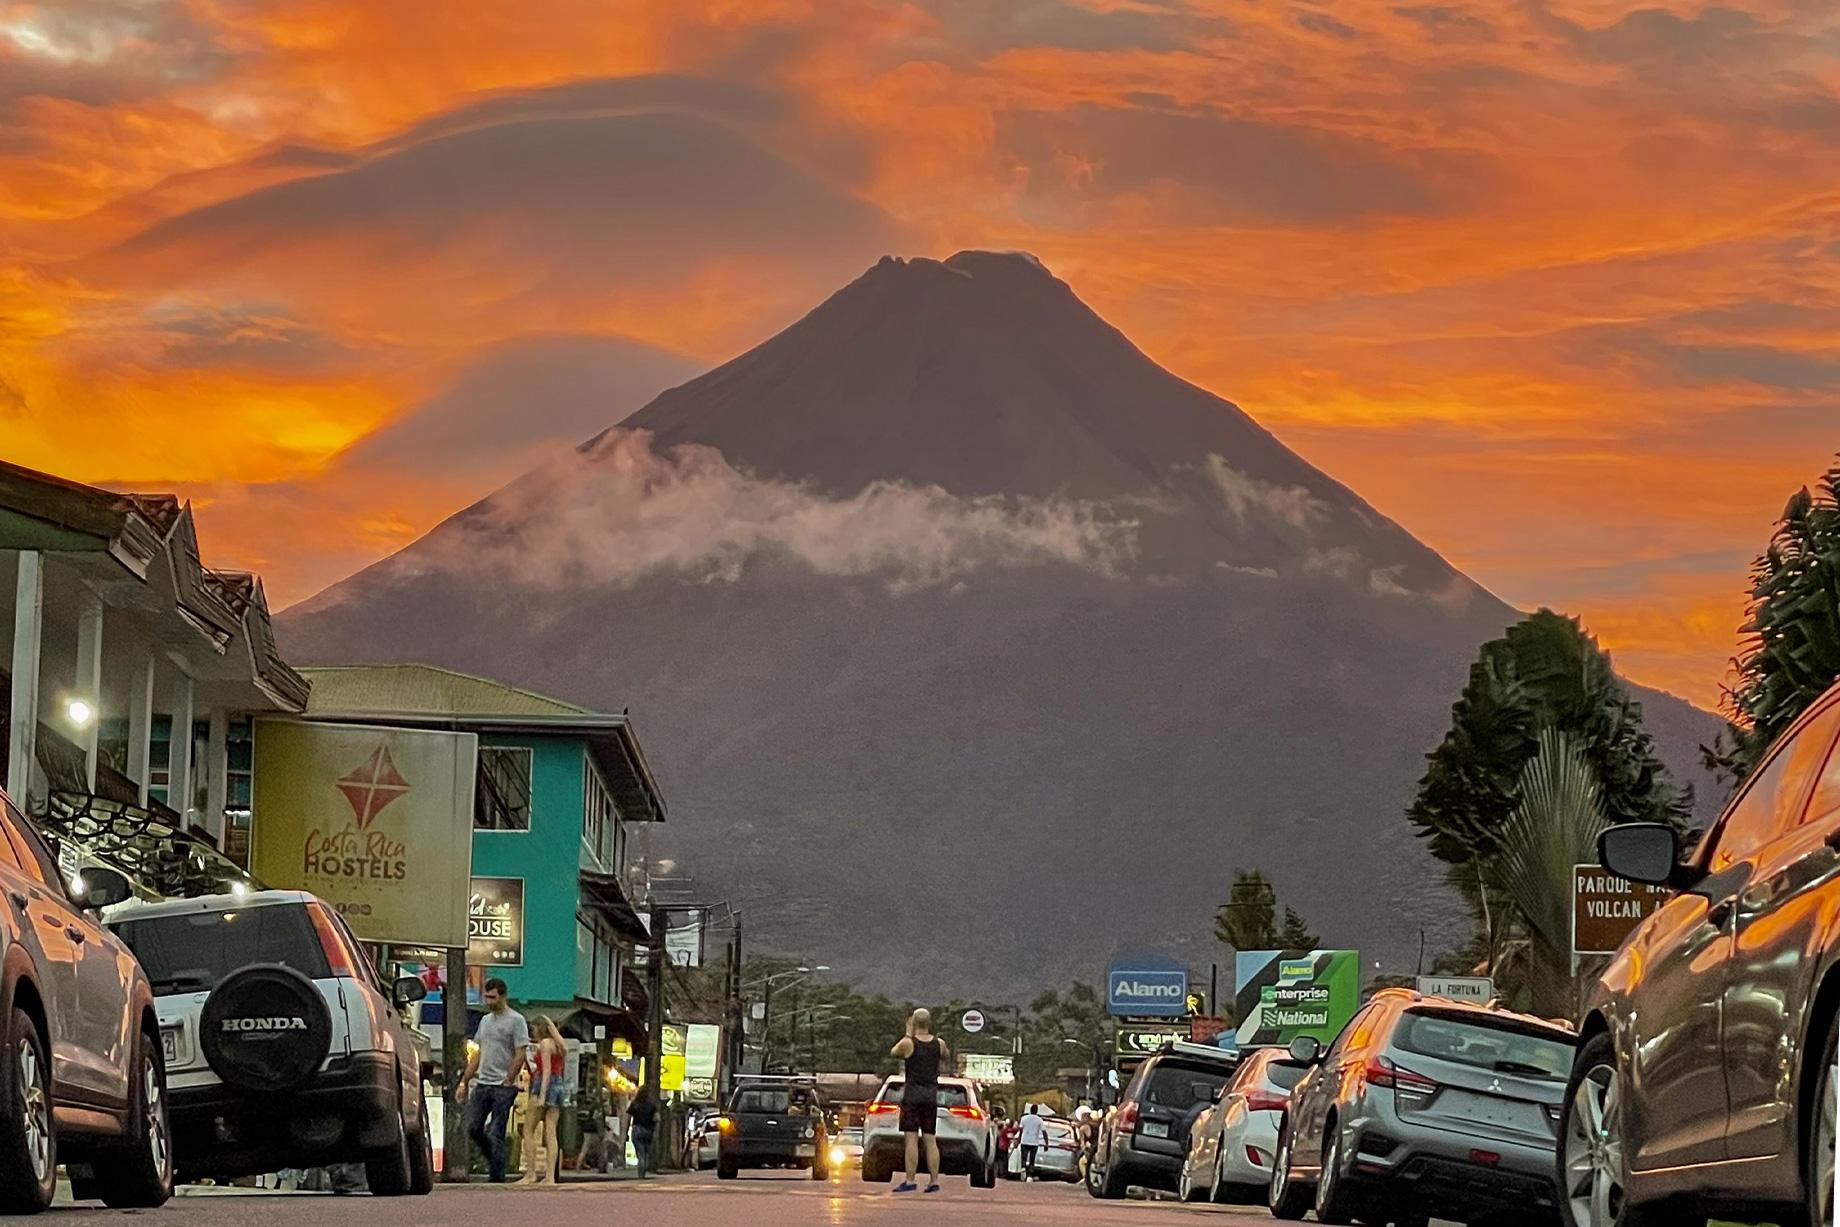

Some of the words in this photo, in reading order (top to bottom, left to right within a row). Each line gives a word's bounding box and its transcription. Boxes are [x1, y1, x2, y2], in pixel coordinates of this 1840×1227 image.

[304, 822, 357, 857] Costa
[366, 831, 406, 859] Rica
[304, 856, 406, 880] HOSTELS
[1577, 876, 1632, 893] PARQUE
[1587, 900, 1641, 918] VOLCAN
[1282, 965, 1312, 975] Alamo
[1115, 980, 1182, 997] Alamo
[1265, 987, 1328, 1001] enterprise
[1432, 984, 1442, 994] LA
[1447, 984, 1480, 996] FORTUNA
[221, 1017, 307, 1031] HONDA
[1277, 1010, 1328, 1026] National
